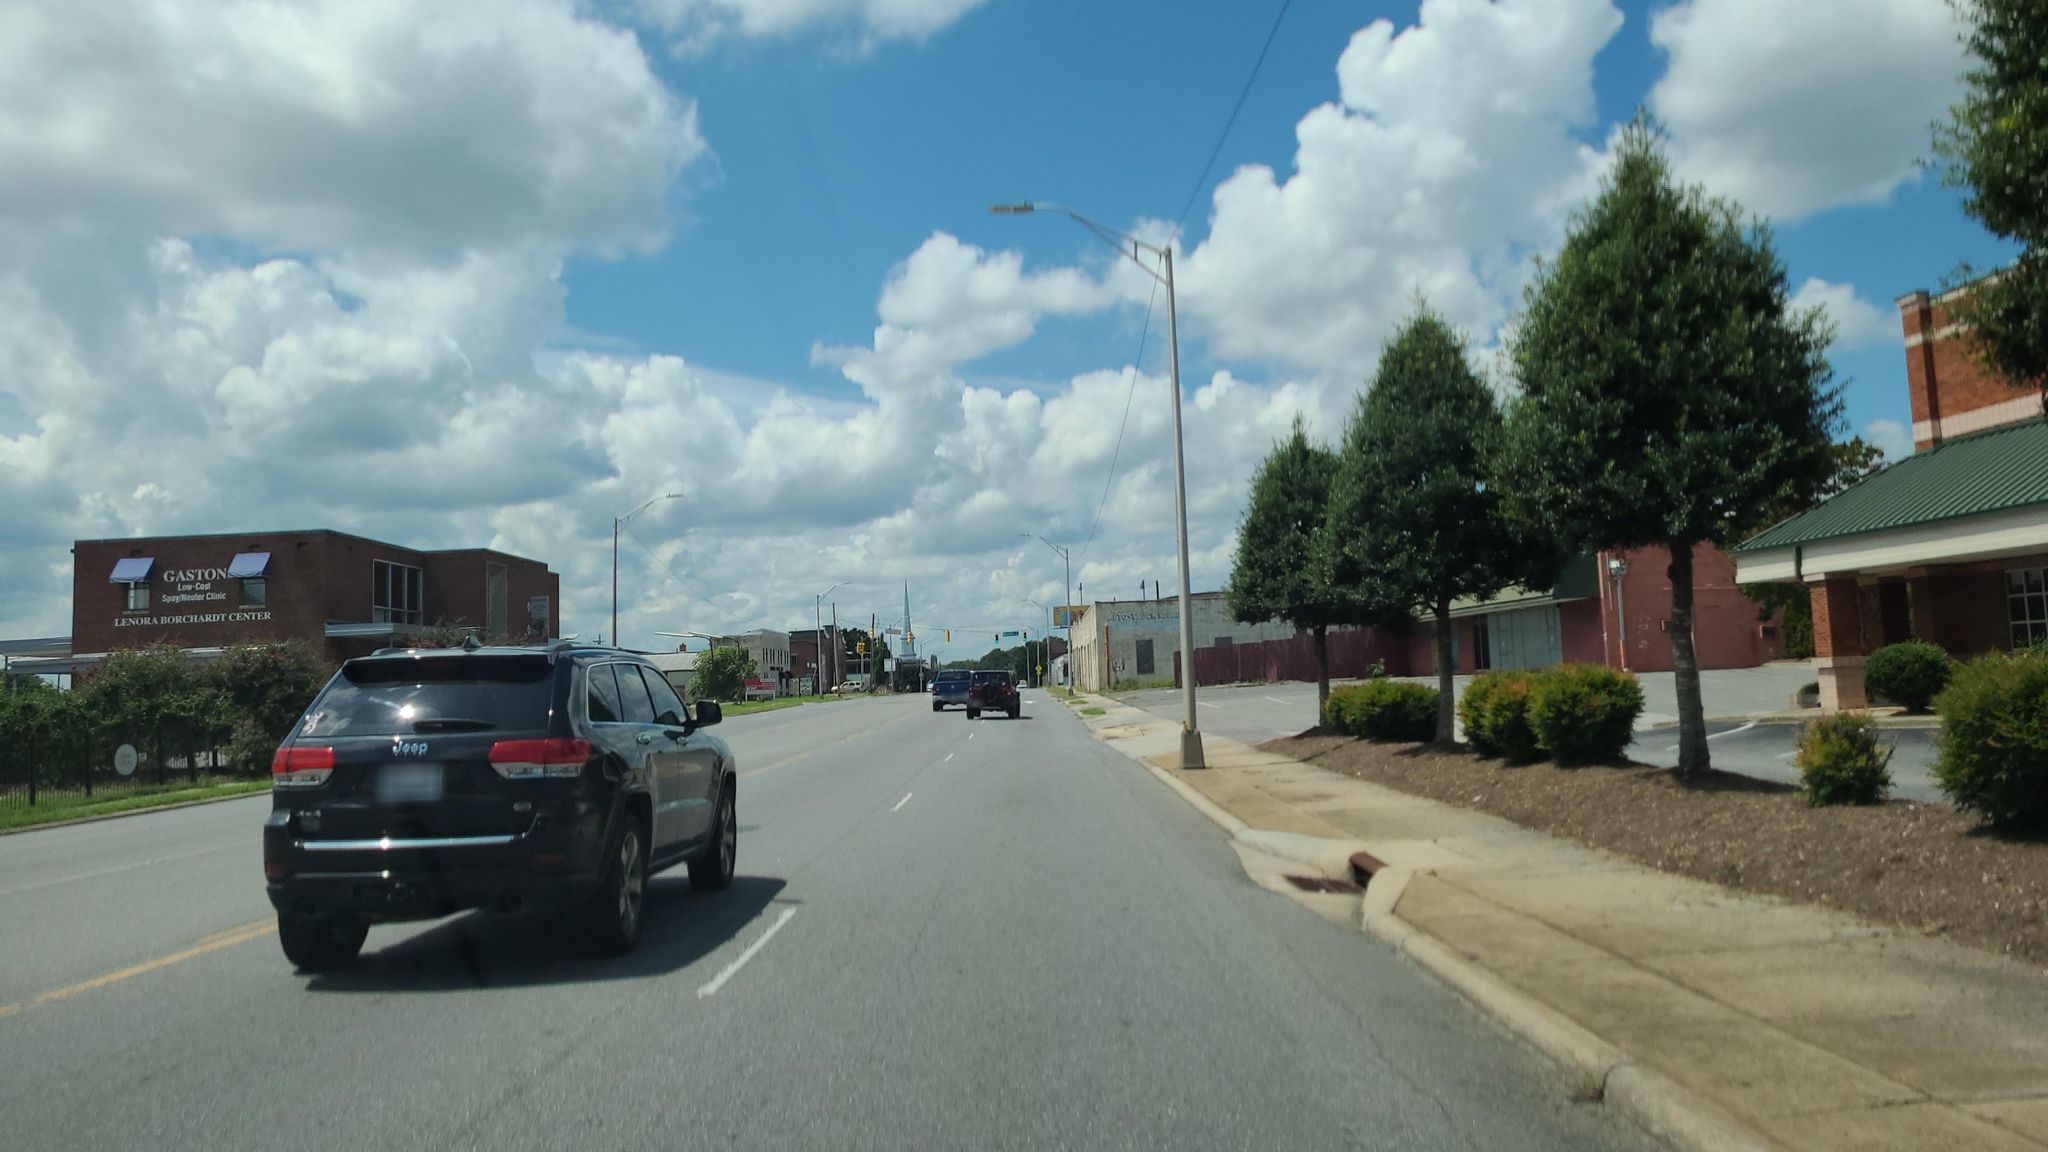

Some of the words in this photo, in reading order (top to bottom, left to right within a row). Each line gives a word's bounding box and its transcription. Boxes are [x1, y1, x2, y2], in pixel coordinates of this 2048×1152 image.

[163, 568, 227, 582] GASTON
[177, 582, 211, 592] Low-Cost
[162, 593, 205, 603] Spay/Neuter
[206, 592, 226, 601] Clinic
[114, 616, 158, 627] LENORA
[161, 613, 227, 624] BORCHARDT
[228, 611, 272, 622] CENTER
[392, 741, 428, 756] Jeep
